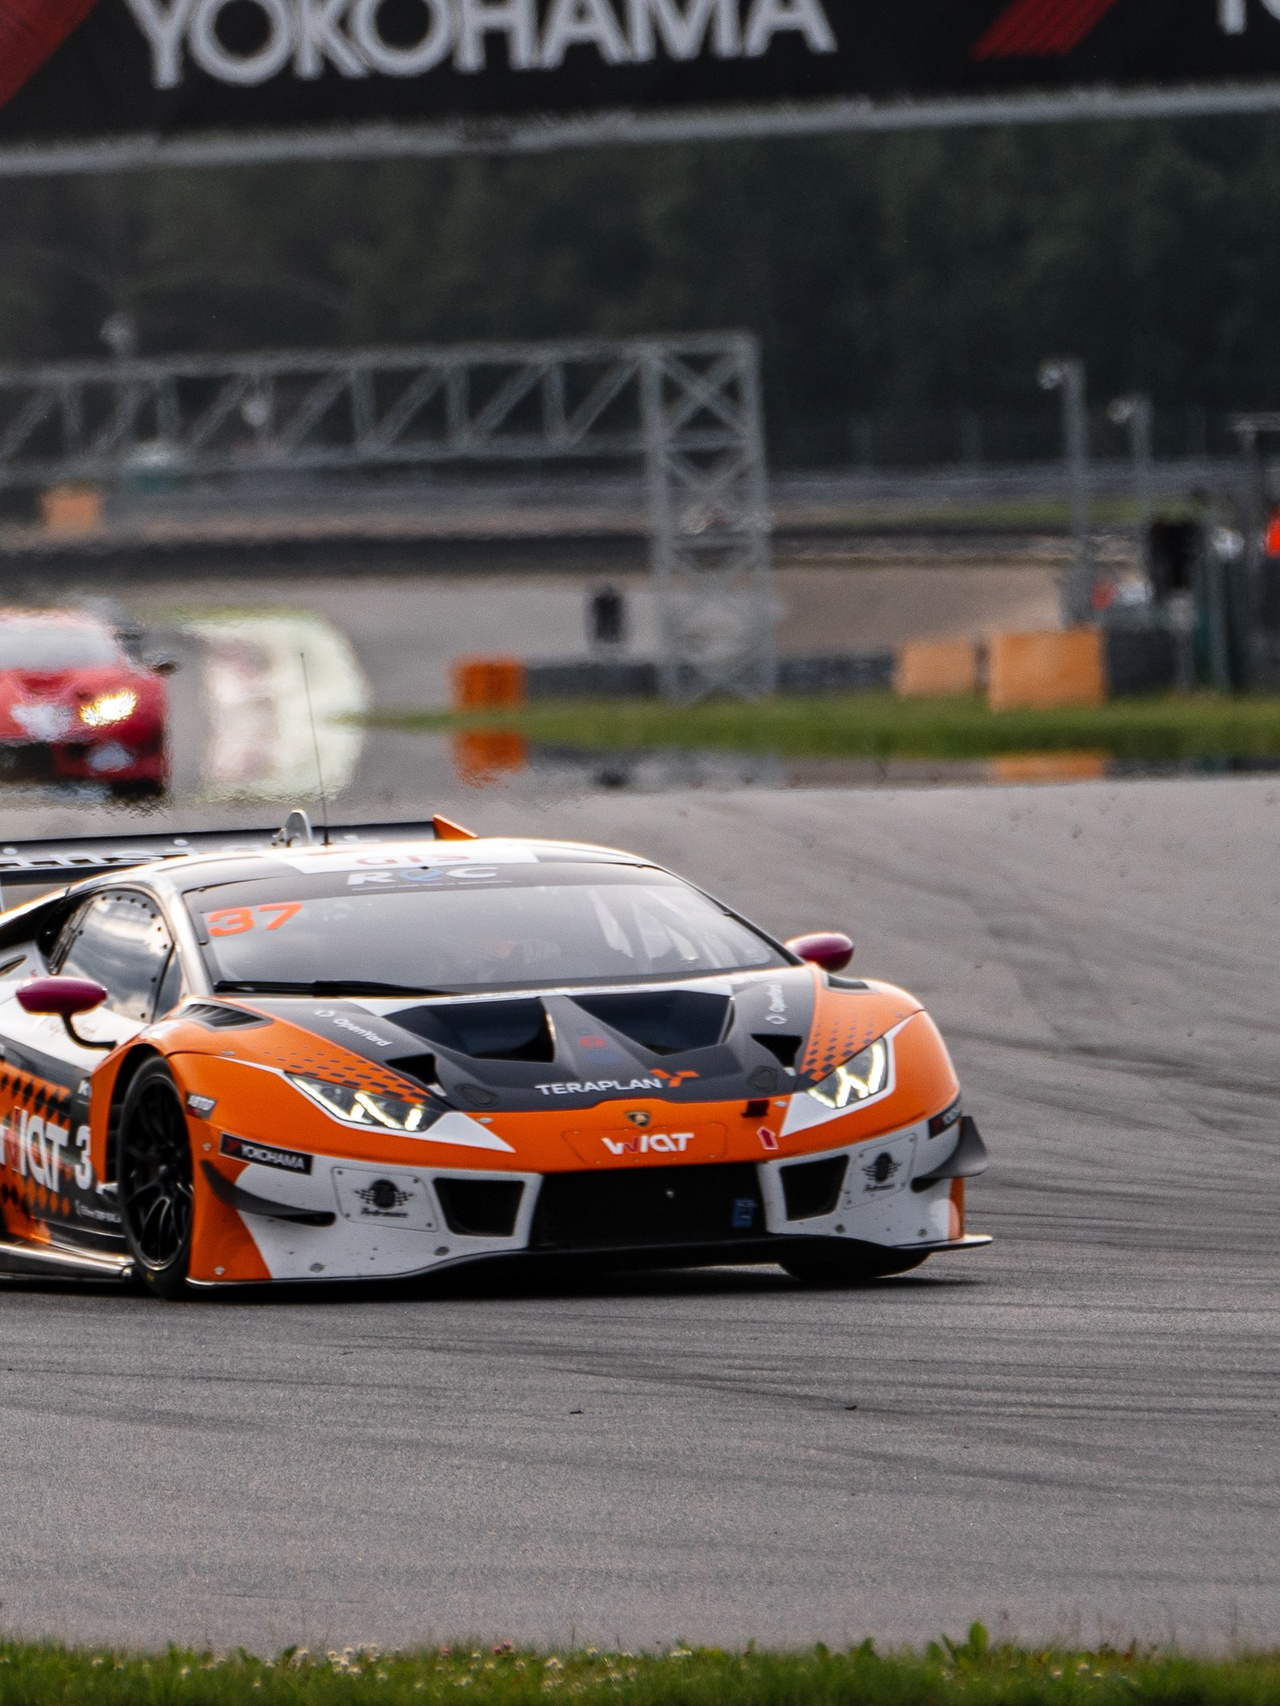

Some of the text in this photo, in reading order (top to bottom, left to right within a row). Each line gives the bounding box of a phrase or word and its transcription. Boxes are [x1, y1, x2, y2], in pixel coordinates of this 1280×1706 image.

[133, 0, 837, 88] YOKOHAMA
[207, 901, 303, 936] 37
[333, 1018, 393, 1047] OpenYard
[535, 1078, 663, 1096] TERAPLAN
[241, 1143, 305, 1171] YOKOHAMA
